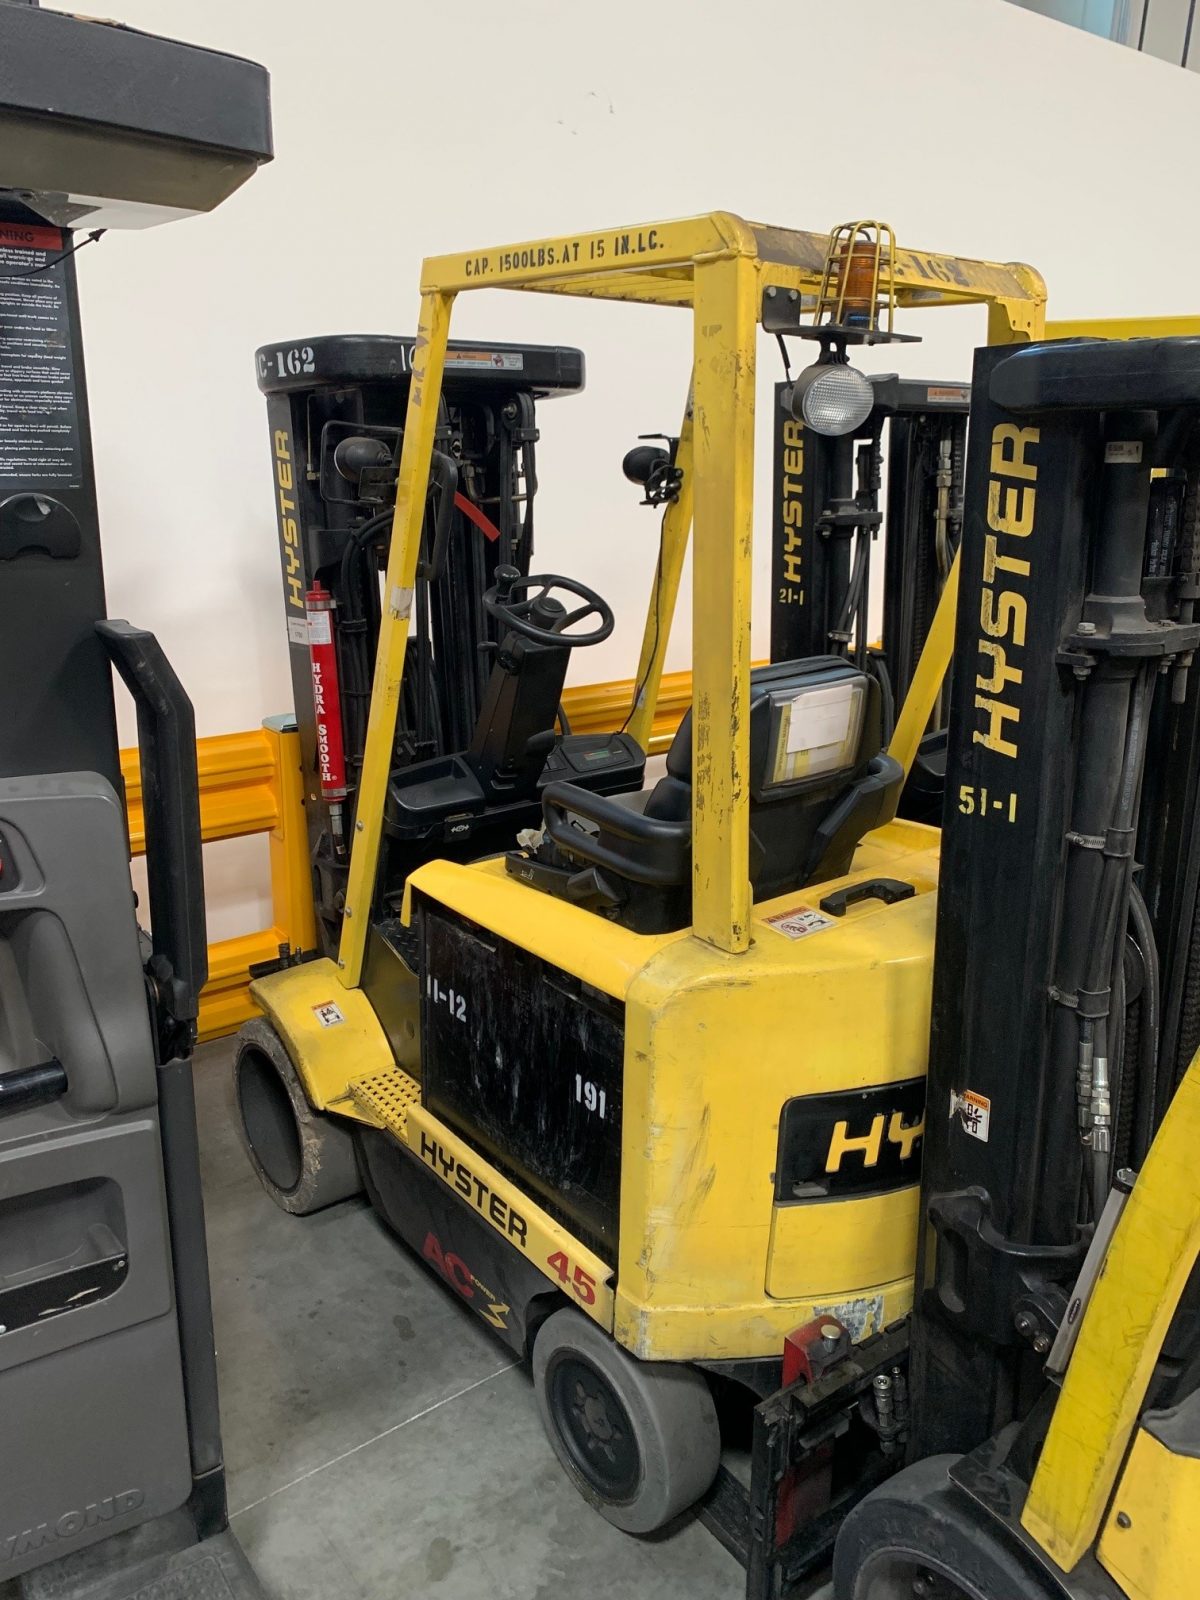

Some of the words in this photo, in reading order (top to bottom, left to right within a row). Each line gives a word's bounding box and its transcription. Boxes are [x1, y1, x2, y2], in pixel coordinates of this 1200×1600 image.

[465, 257, 494, 277] CAP.
[589, 239, 605, 260] 15
[275, 429, 304, 608] HYSTER
[783, 418, 804, 583] HYSTER
[972, 422, 1041, 759] HYSTER
[312, 662, 326, 715] HYDRA
[574, 1072, 607, 1120] 191
[420, 1131, 528, 1248] HYSTER
[423, 1231, 474, 1299] AC
[546, 1250, 596, 1306] 45
